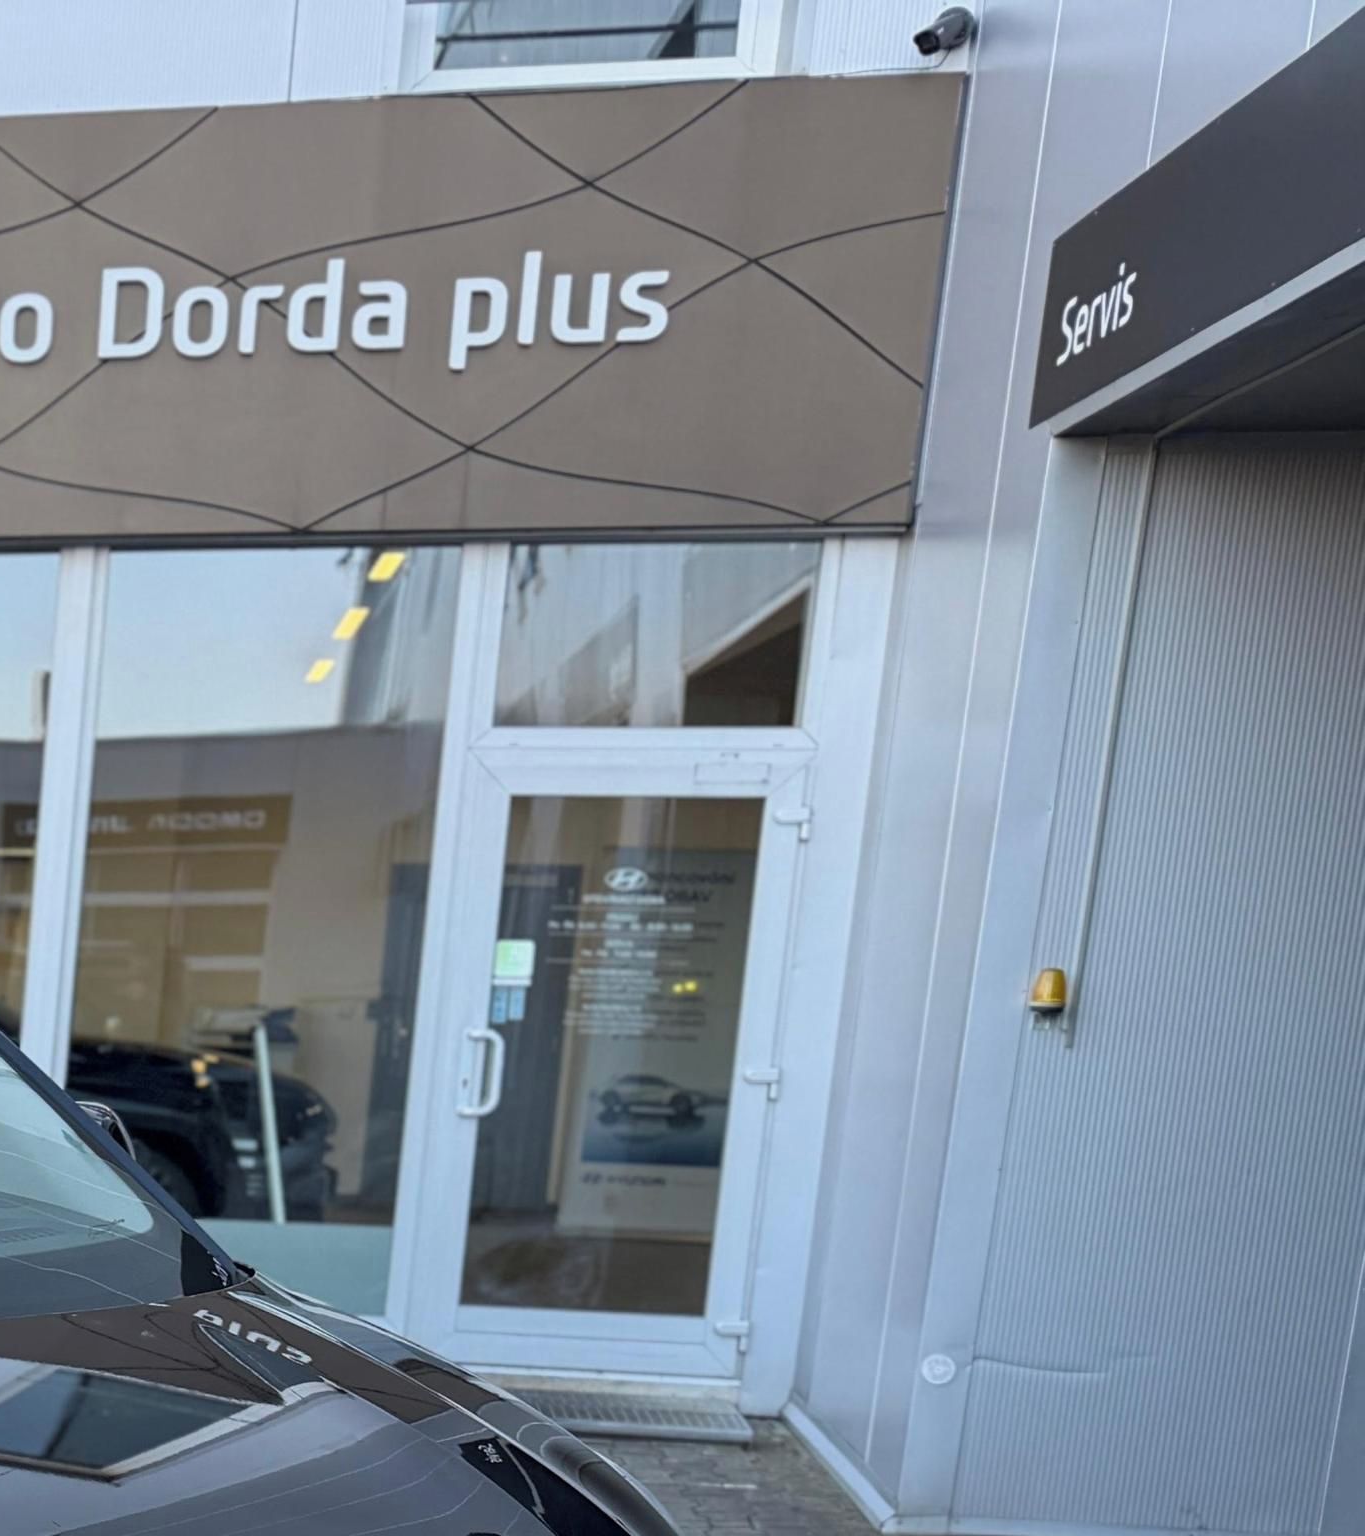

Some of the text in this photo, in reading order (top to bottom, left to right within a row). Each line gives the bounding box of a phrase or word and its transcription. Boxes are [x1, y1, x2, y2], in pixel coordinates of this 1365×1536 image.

[97, 258, 408, 360] Dorda
[448, 250, 671, 370] plus
[1055, 262, 1137, 367] Servis
